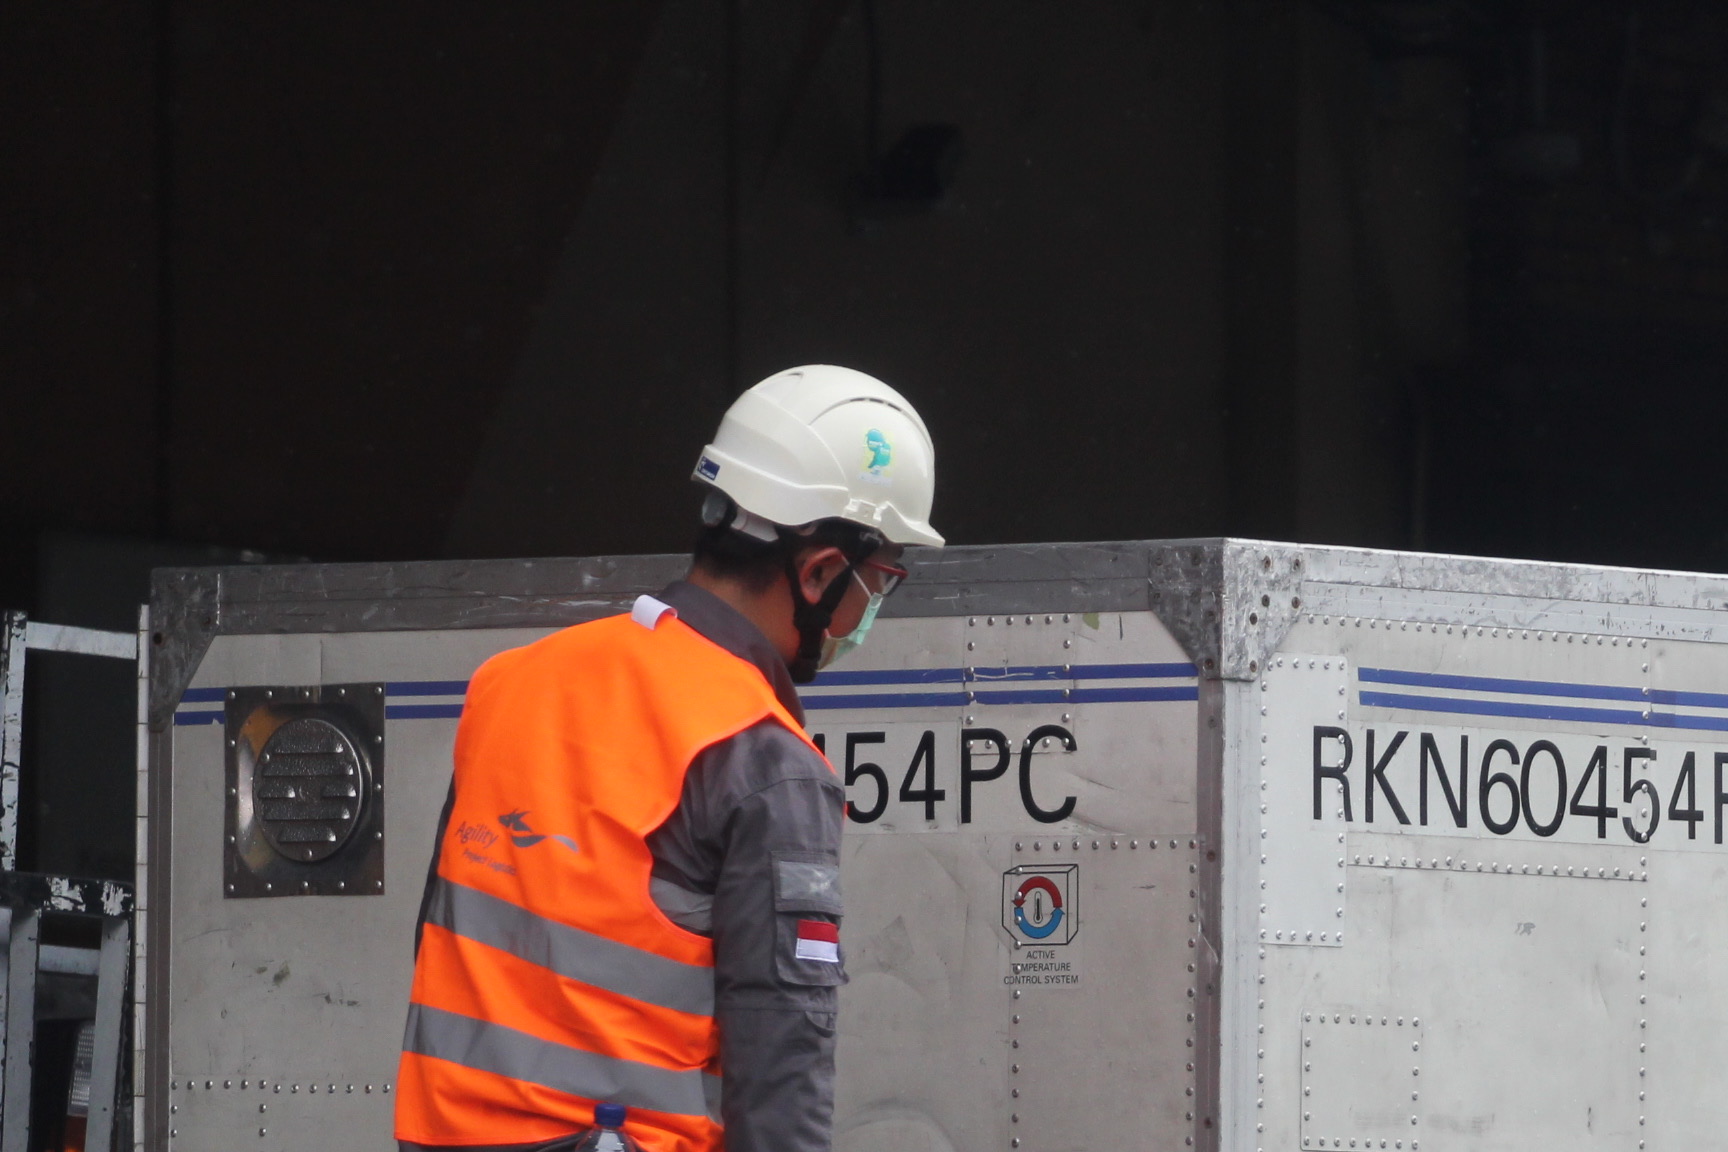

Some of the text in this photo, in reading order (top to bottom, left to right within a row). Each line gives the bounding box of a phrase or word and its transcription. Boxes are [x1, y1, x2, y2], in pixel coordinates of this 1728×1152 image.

[811, 724, 1078, 824] 54PC
[455, 820, 499, 848] Agility
[1026, 950, 1056, 959] ACTIVE
[1011, 962, 1071, 972] TMPERATURE
[1003, 975, 1079, 985] CONTROL SYSTEM
